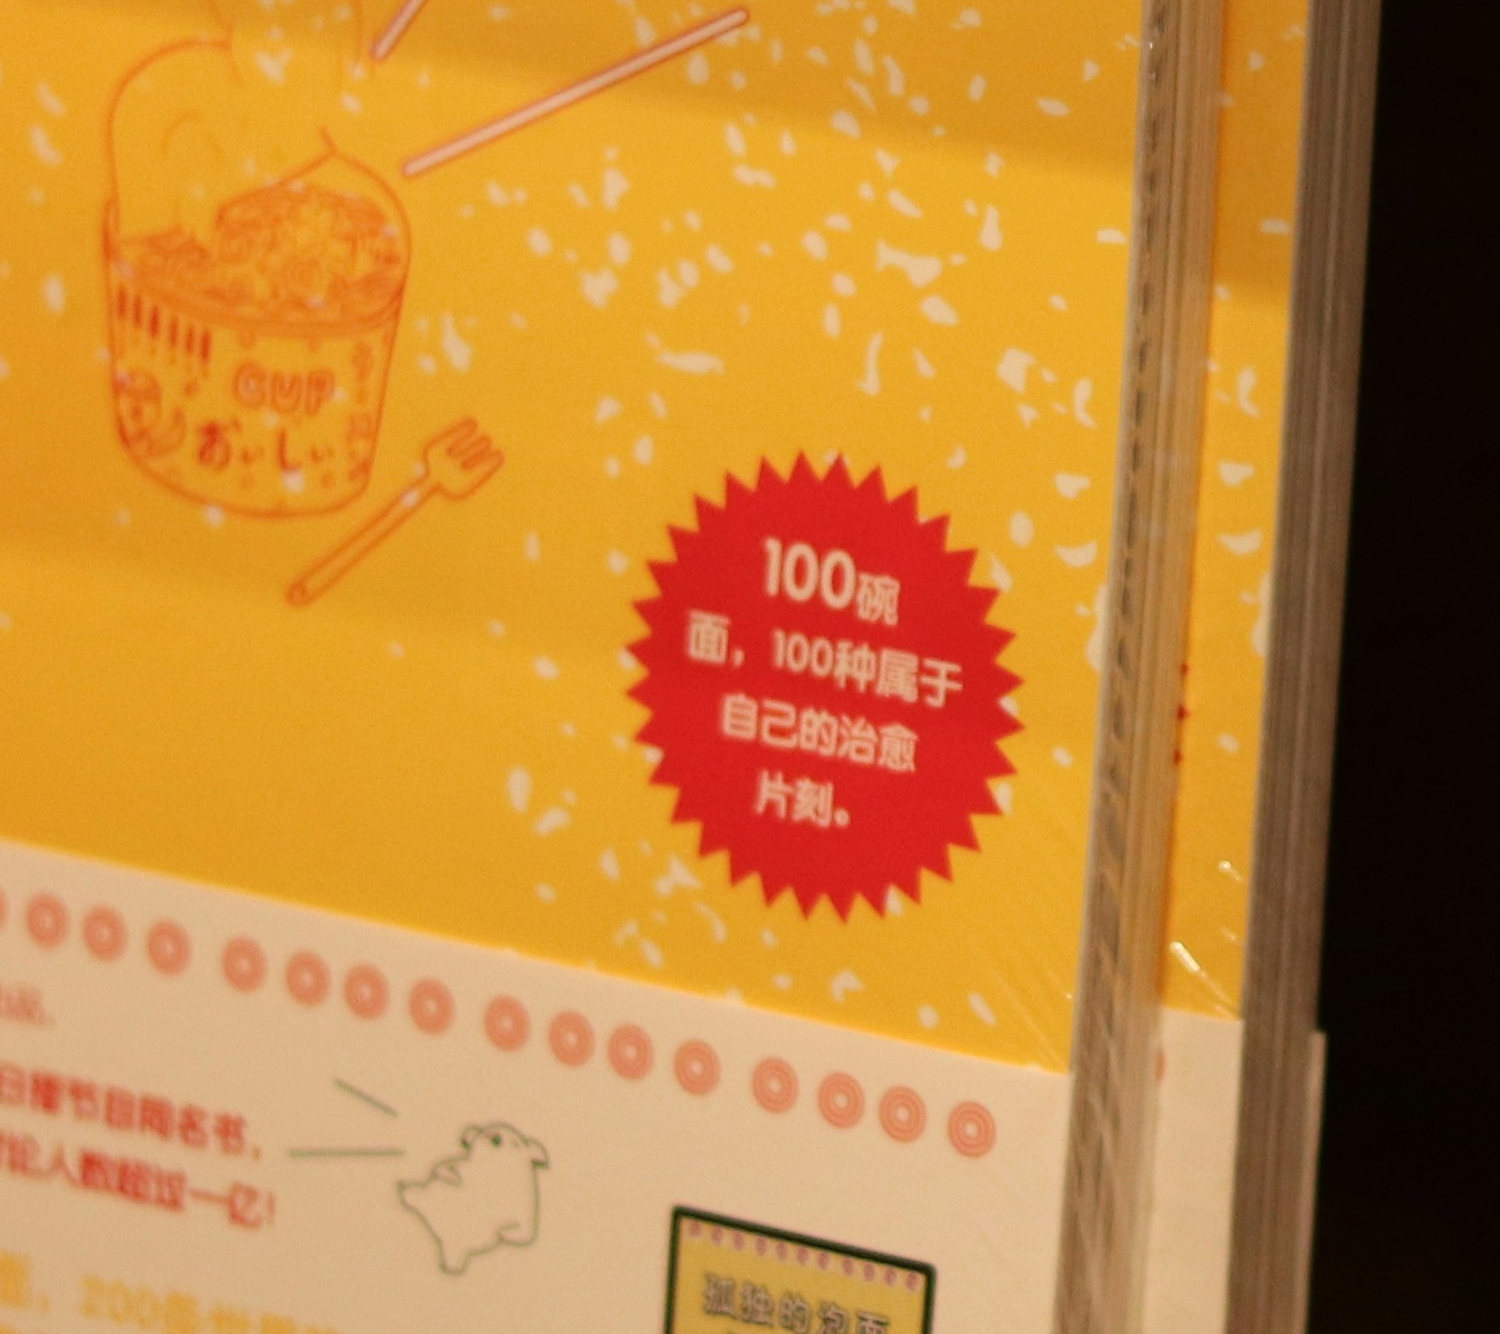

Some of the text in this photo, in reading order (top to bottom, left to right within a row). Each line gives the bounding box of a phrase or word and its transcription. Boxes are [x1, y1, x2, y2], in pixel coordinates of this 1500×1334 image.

[761, 537, 901, 626] 100碗
[684, 610, 963, 709] 面，100种属于
[720, 694, 917, 773] 自己的治愈
[754, 771, 852, 830] 片刻。
